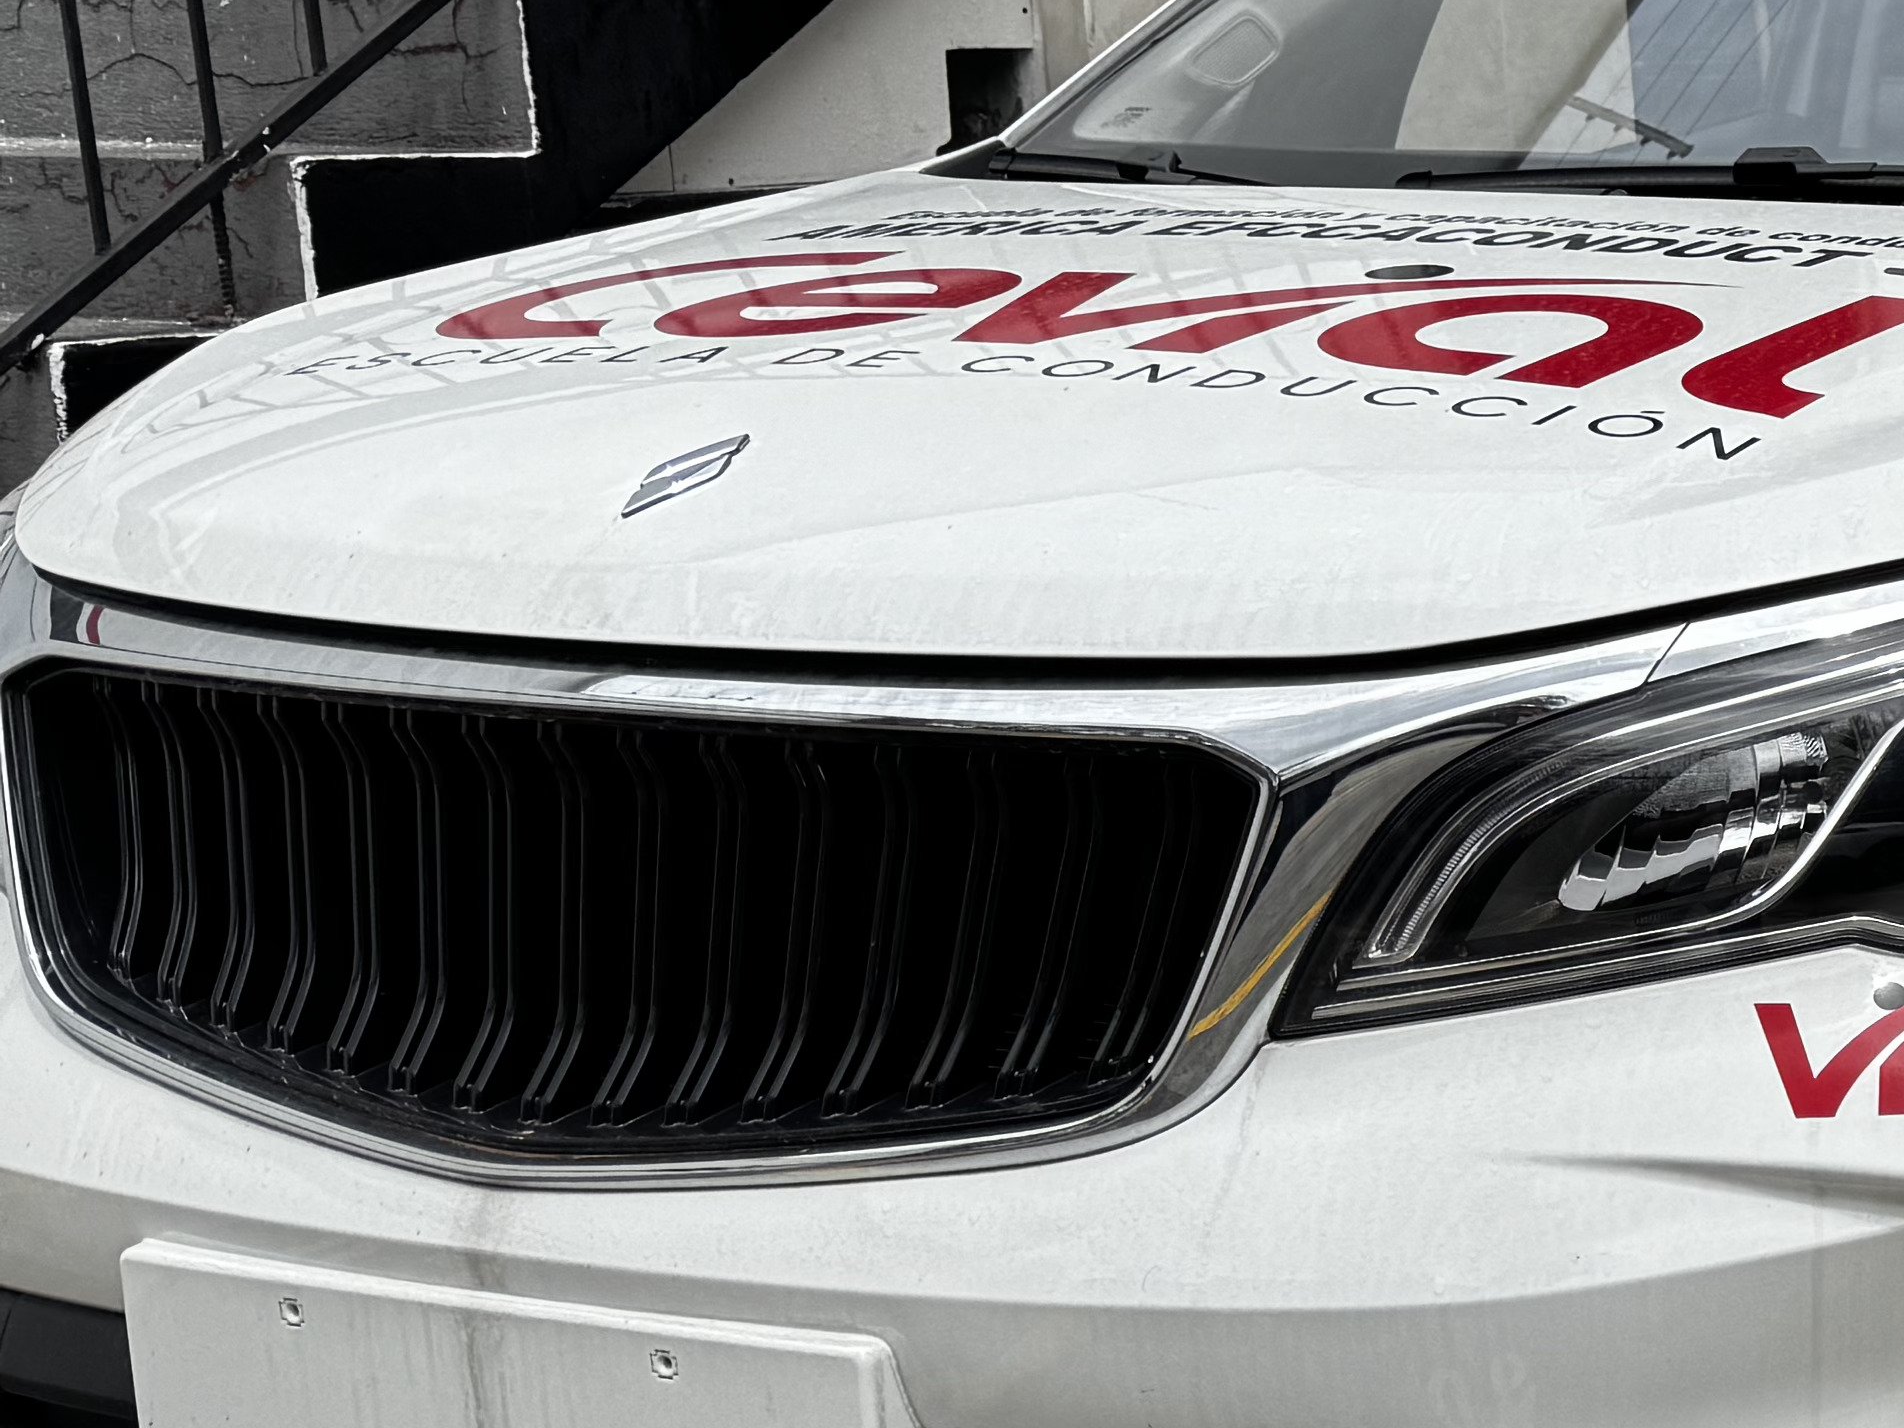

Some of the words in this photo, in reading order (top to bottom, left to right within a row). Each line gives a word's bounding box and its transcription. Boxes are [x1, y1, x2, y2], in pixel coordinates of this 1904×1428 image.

[764, 219, 1149, 242] AMERICA
[1694, 225, 1760, 238] de
[286, 344, 730, 376] ESCUELA
[772, 347, 922, 371] DE
[961, 355, 1762, 462] CONDUCCIÓN
